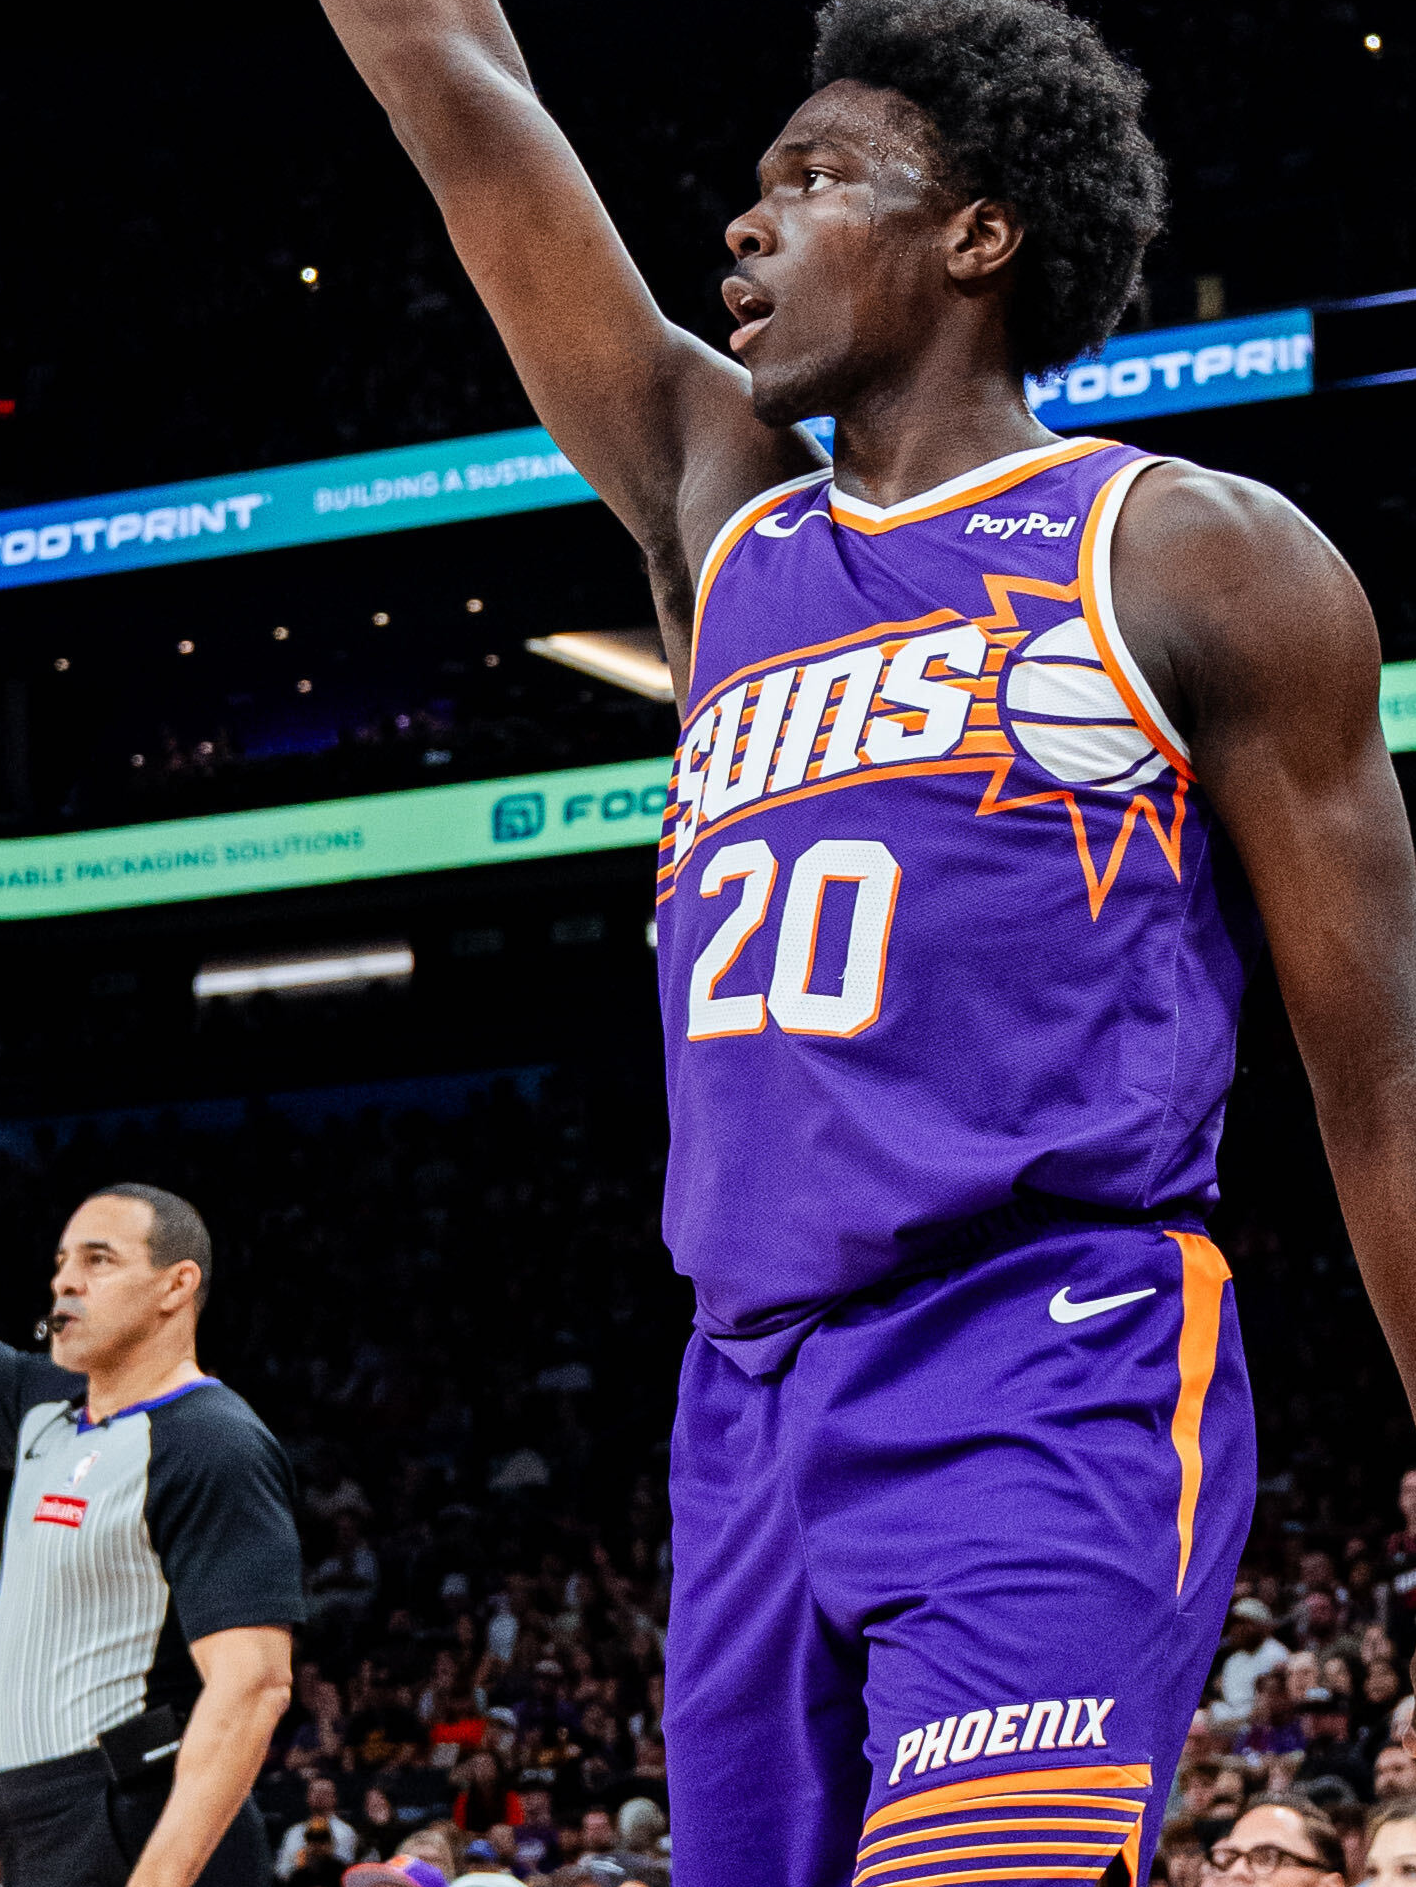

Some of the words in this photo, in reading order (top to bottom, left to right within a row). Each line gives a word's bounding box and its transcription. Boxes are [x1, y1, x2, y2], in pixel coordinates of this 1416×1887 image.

[313, 471, 440, 514] BUILDING
[442, 468, 463, 492] A
[964, 512, 1077, 540] PayPal
[76, 844, 217, 881] PACKAGING
[224, 827, 365, 864] SOLUTIONS
[687, 838, 901, 1041] 20
[888, 1697, 1116, 1786] PHOENIX
